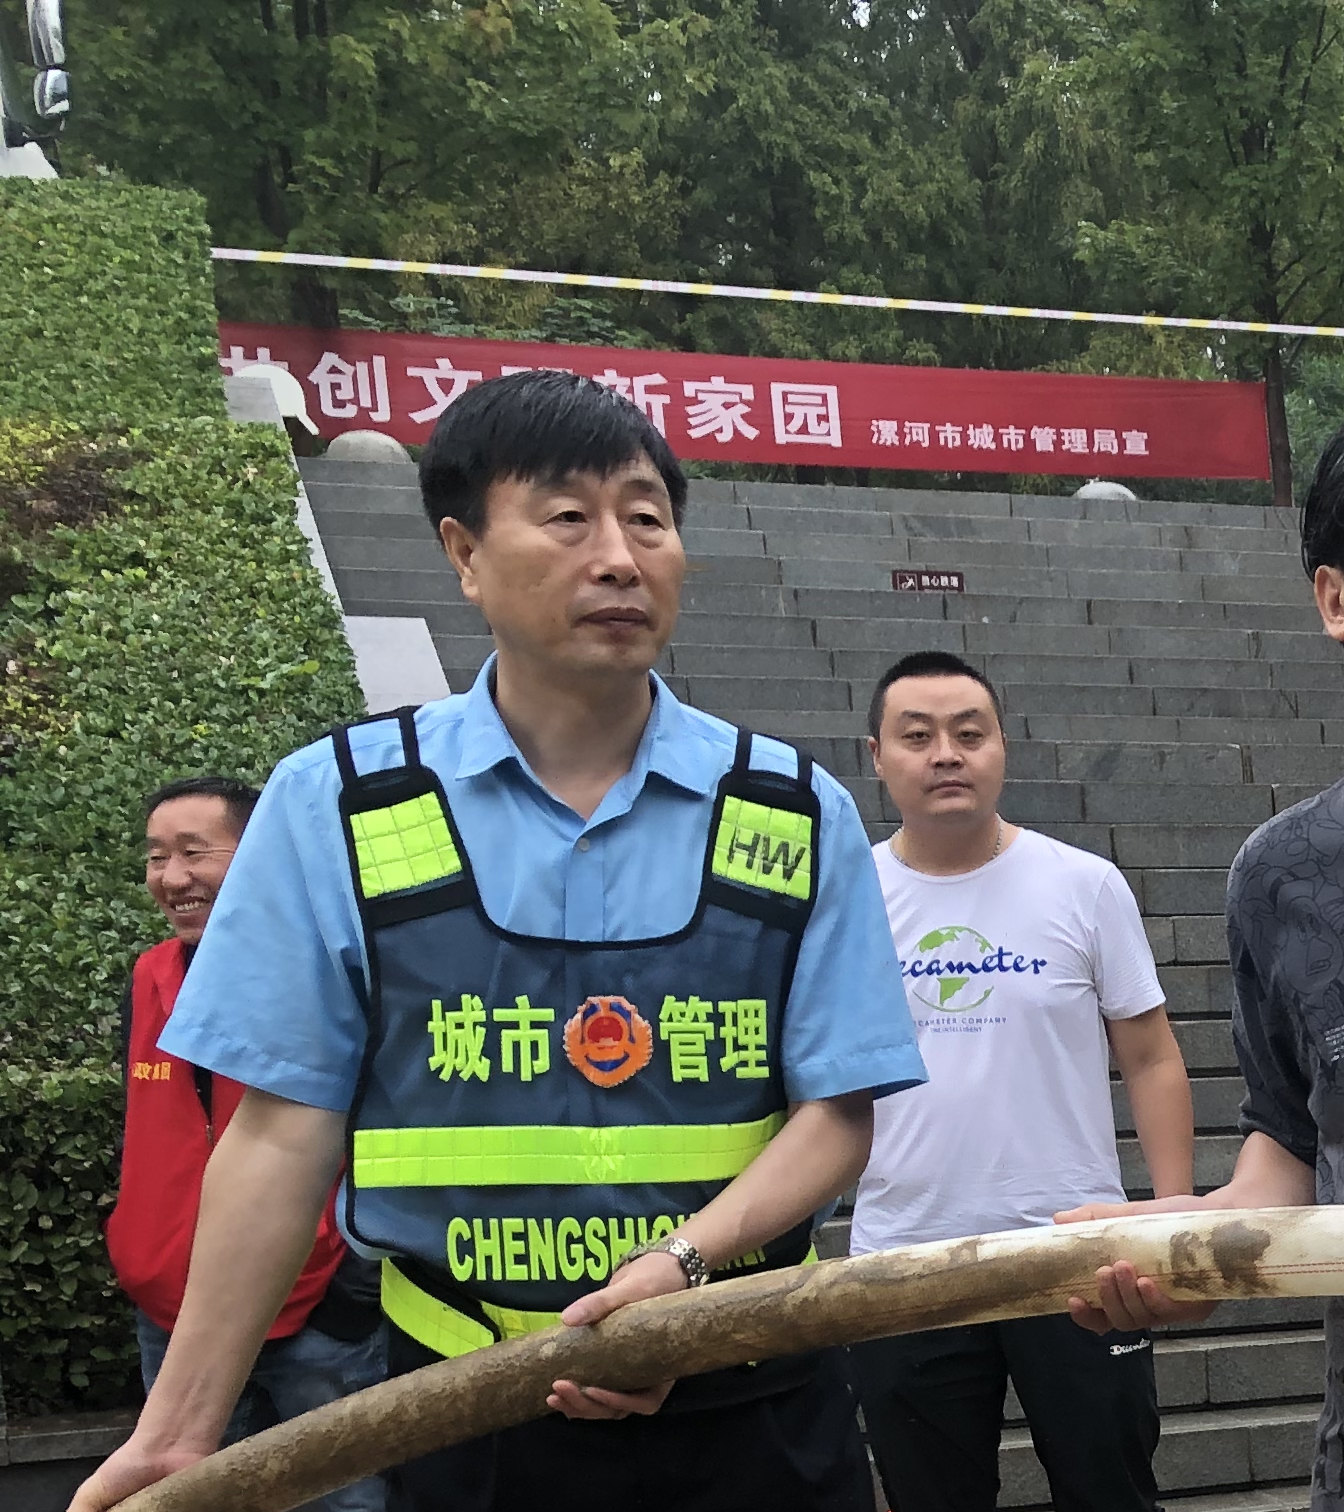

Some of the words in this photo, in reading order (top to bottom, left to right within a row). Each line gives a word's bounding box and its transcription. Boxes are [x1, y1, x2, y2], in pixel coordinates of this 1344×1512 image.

[870, 419, 1149, 455] 漯河市城市管理局宣
[727, 826, 806, 881] HW
[427, 993, 555, 1082] 城市
[659, 994, 770, 1083] 管理
